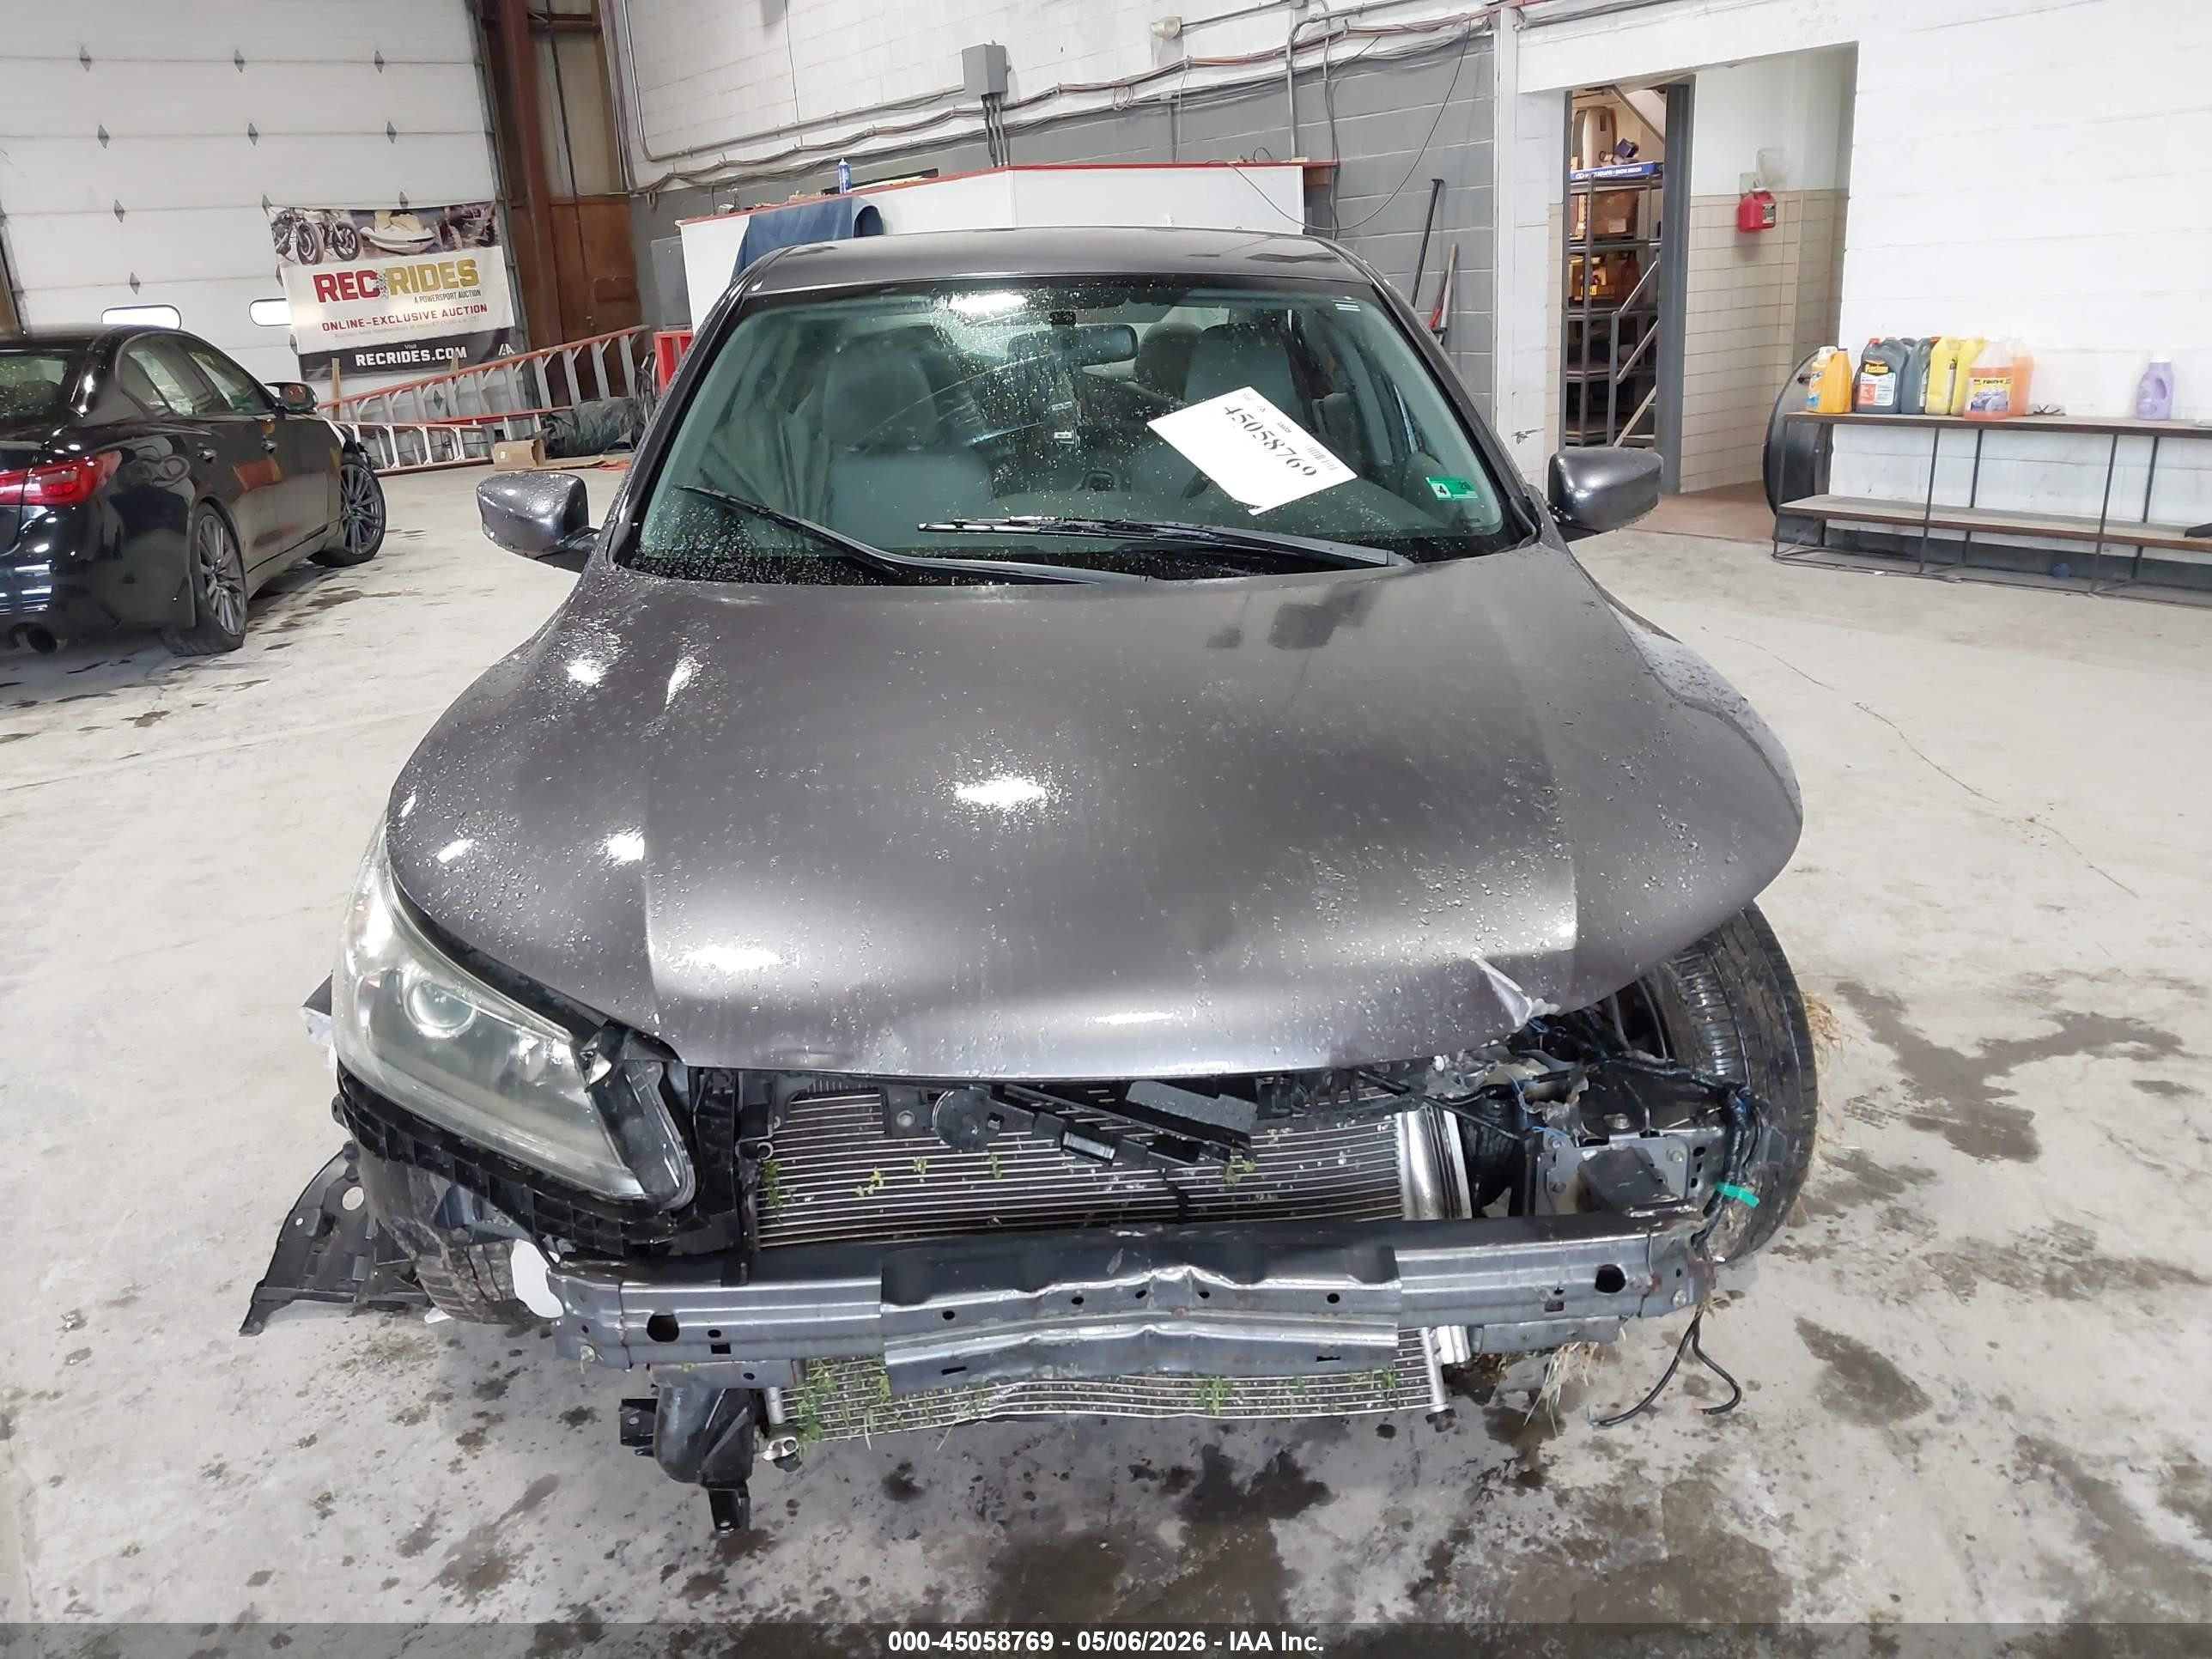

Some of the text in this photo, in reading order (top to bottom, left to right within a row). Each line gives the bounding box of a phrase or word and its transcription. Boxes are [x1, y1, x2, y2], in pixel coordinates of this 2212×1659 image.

[313, 259, 480, 303] REC RIDES
[419, 292, 457, 303] POWERSPORT
[458, 289, 481, 299] AUCTION
[322, 310, 438, 331] ONLINE-EXCLUSIVE
[441, 304, 488, 318] AUCTION
[355, 347, 467, 368] RECRIDES.COM
[1224, 406, 1317, 476] 45058769
